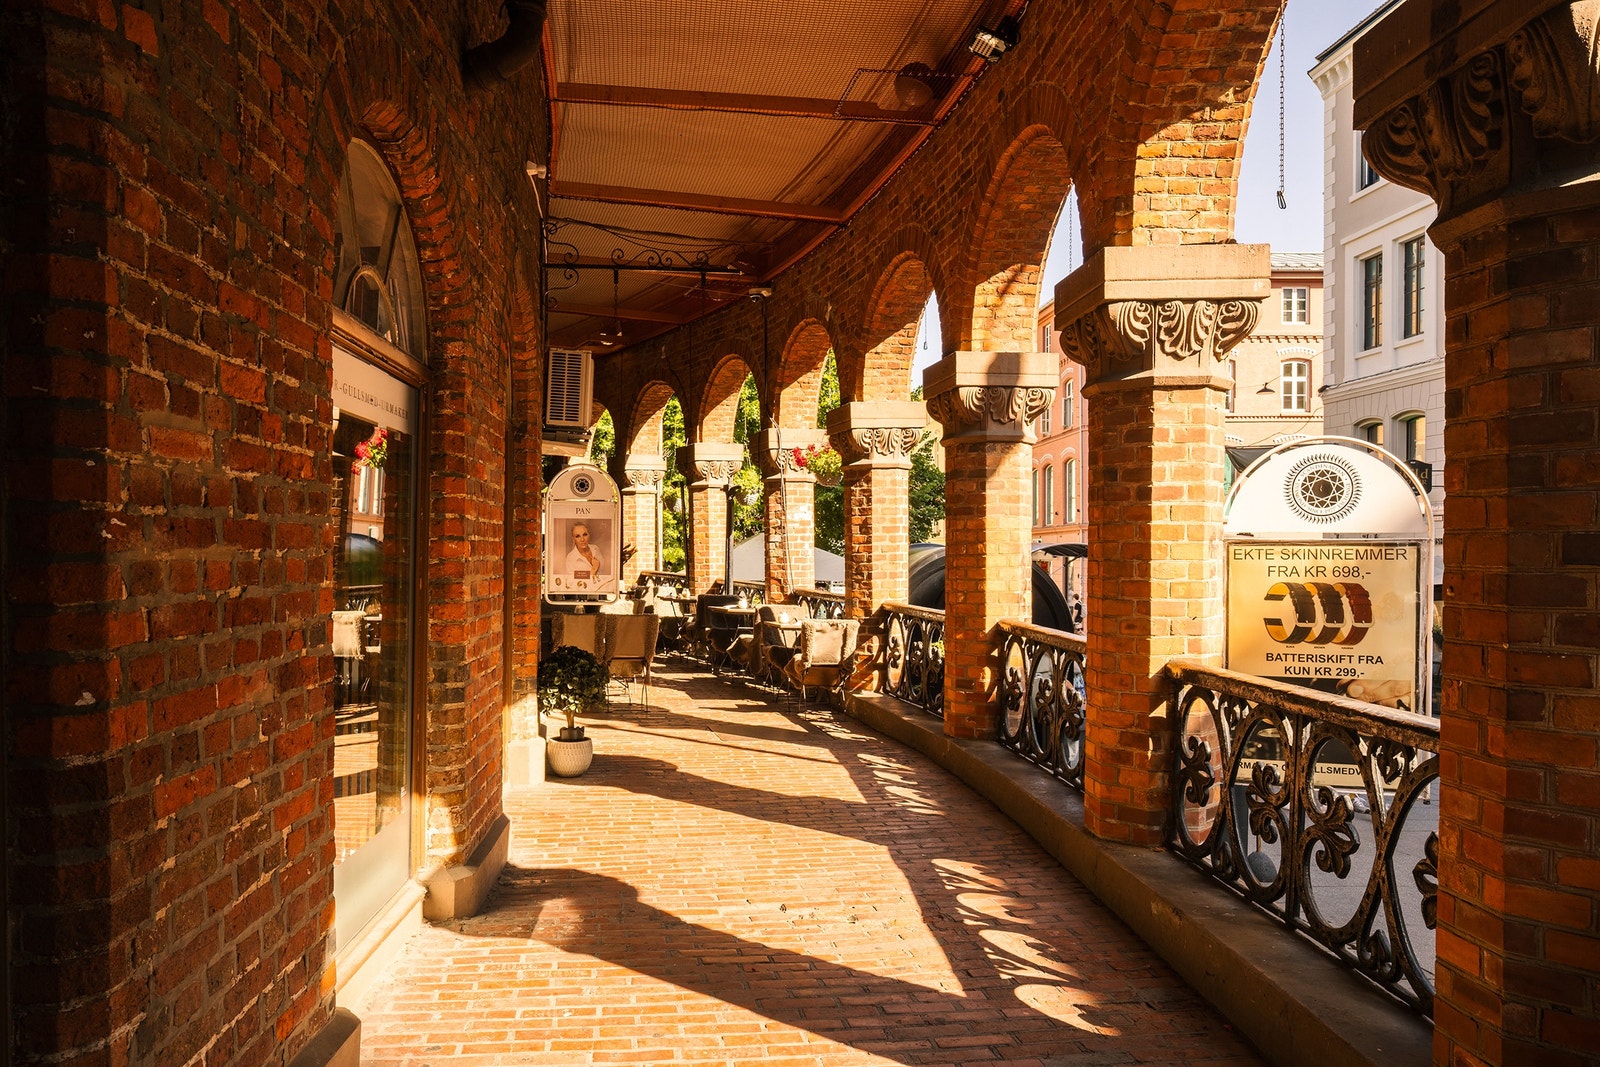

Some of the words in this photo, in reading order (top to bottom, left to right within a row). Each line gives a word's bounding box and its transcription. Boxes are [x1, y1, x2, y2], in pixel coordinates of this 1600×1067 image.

[575, 507, 591, 515] PAN
[1233, 548, 1275, 560] EKTE
[1280, 548, 1408, 560] SKINNREMMER
[1268, 565, 1300, 578] FRA
[1305, 565, 1327, 578] KR
[1332, 565, 1372, 579] 698,-
[1266, 653, 1354, 664] BATTERISKIFT
[1358, 655, 1384, 665] FRA
[1284, 666, 1310, 676] KUN
[1314, 667, 1332, 676] KR
[1336, 667, 1364, 678] 299,-
[1314, 766, 1361, 776] LLSMEDV
